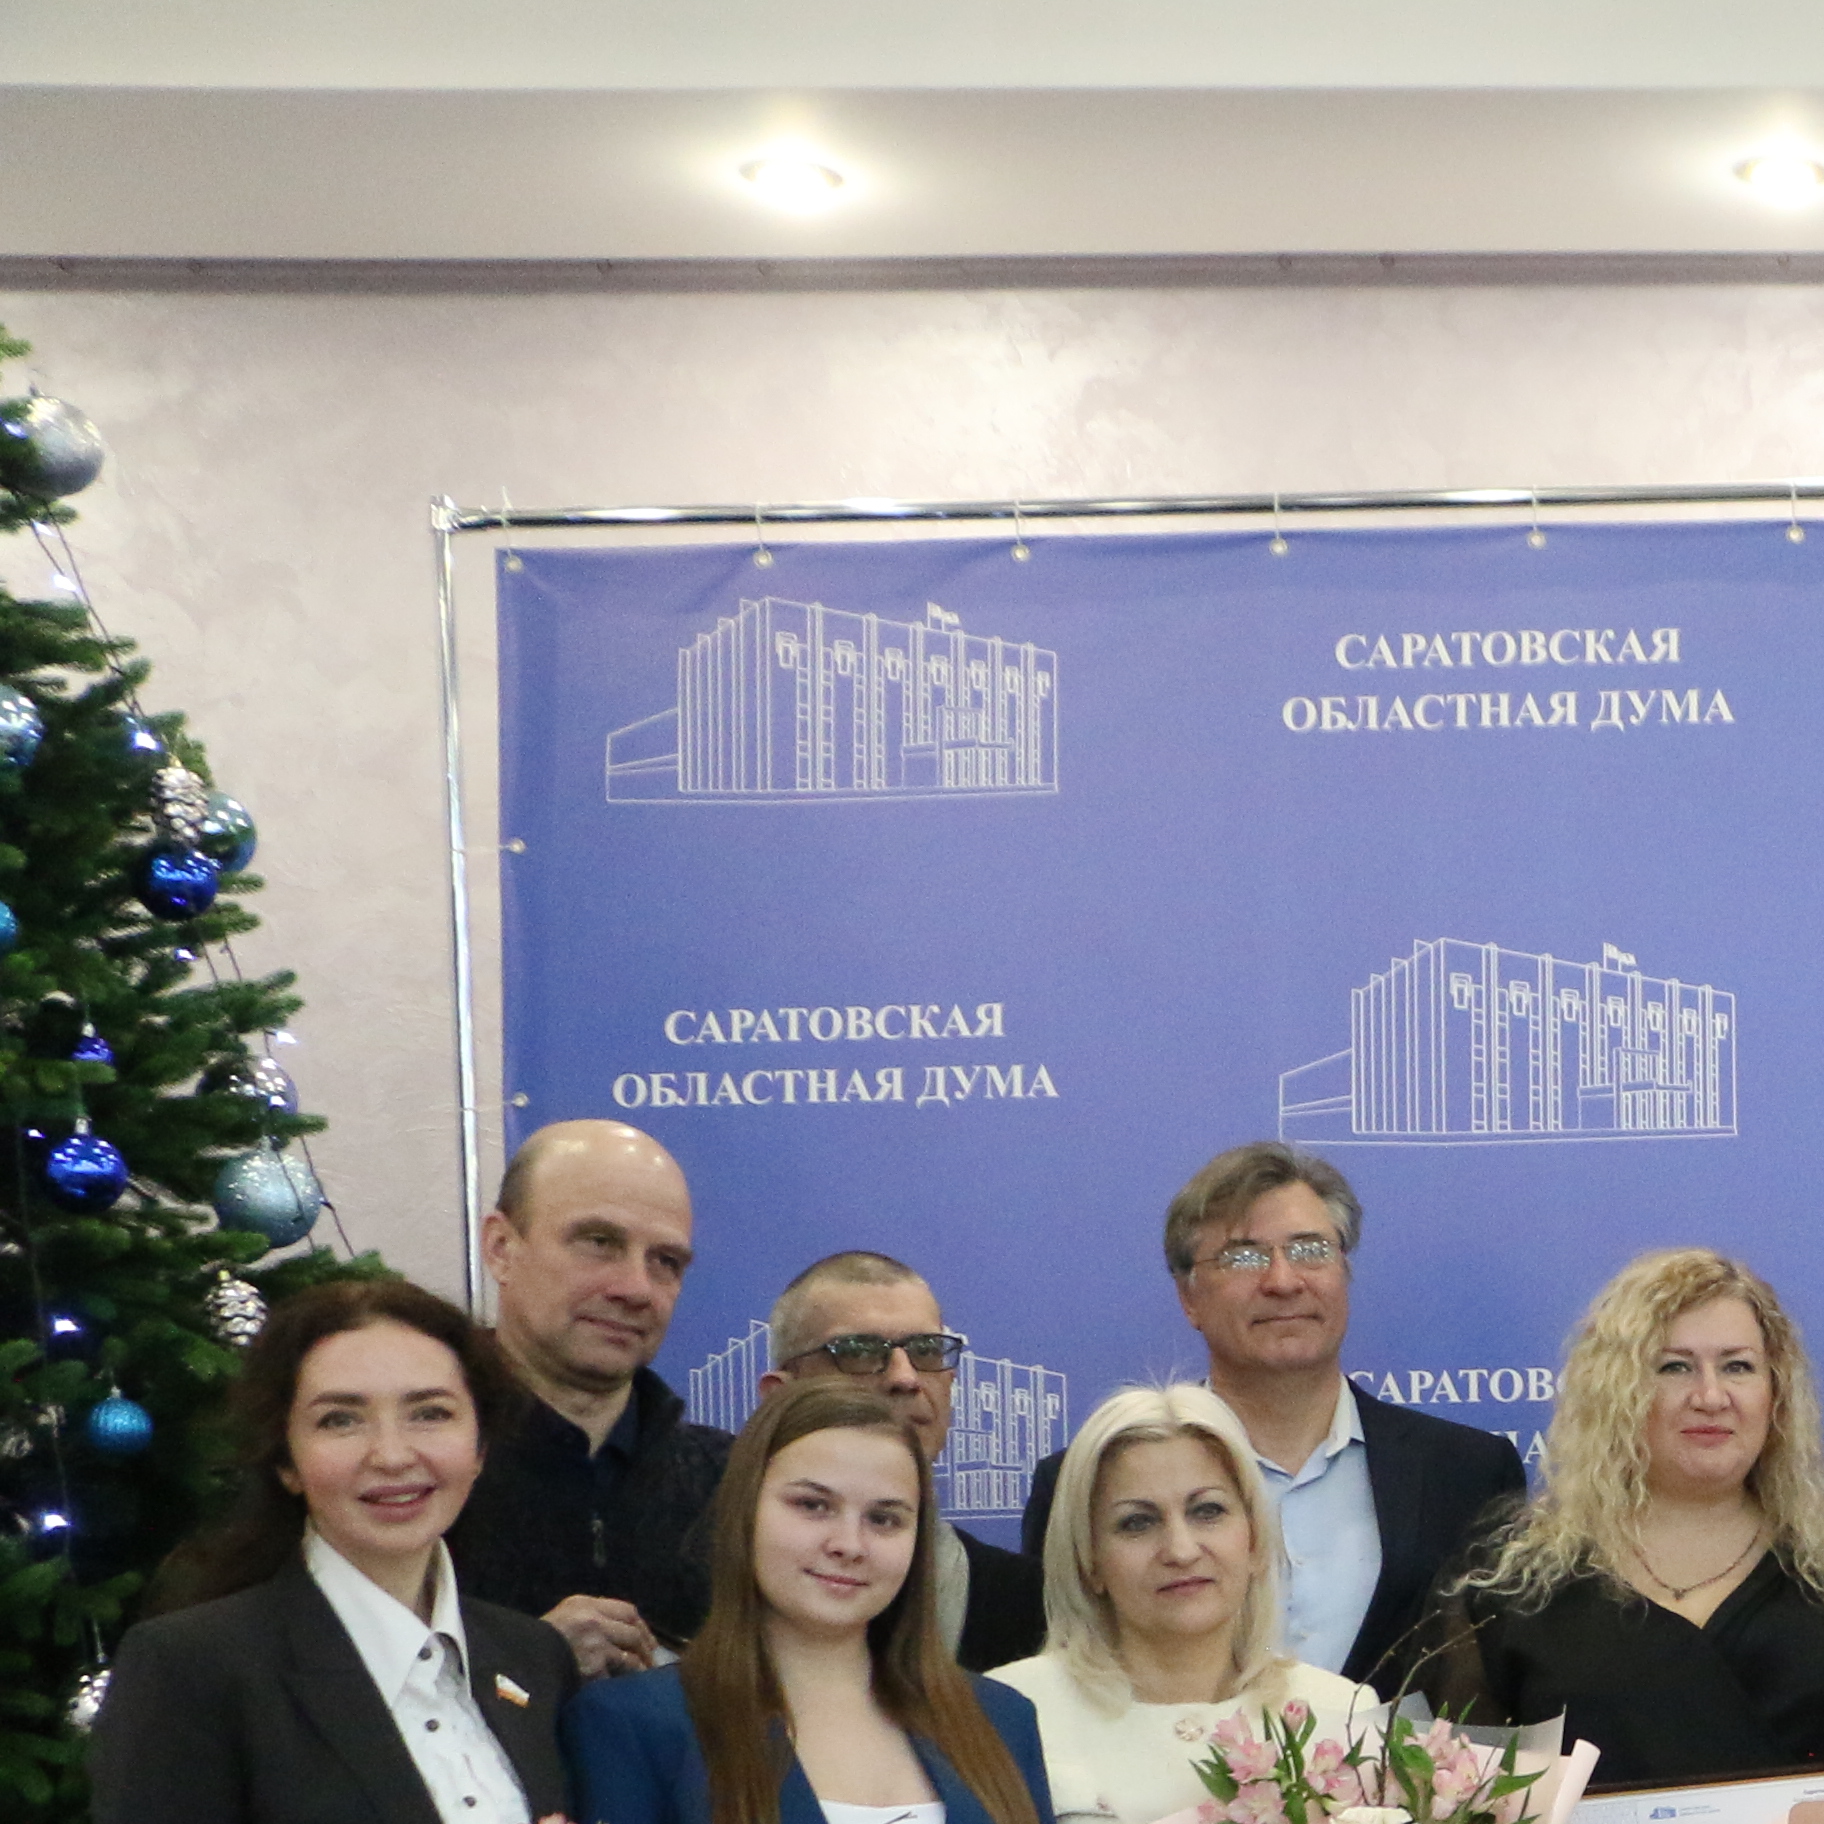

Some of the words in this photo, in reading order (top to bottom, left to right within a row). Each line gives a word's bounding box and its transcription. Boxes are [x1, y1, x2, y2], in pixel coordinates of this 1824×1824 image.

[1336, 629, 1681, 670] САРАТОВСКАЯ
[1283, 690, 1579, 733] ОБЛАСТНАЯ
[1591, 689, 1736, 732] ДУМА
[665, 1003, 1006, 1046] САРАТОВСКАЯ
[614, 1067, 906, 1109] ОБЛАСТНАЯ
[917, 1065, 1060, 1108] ДУМА
